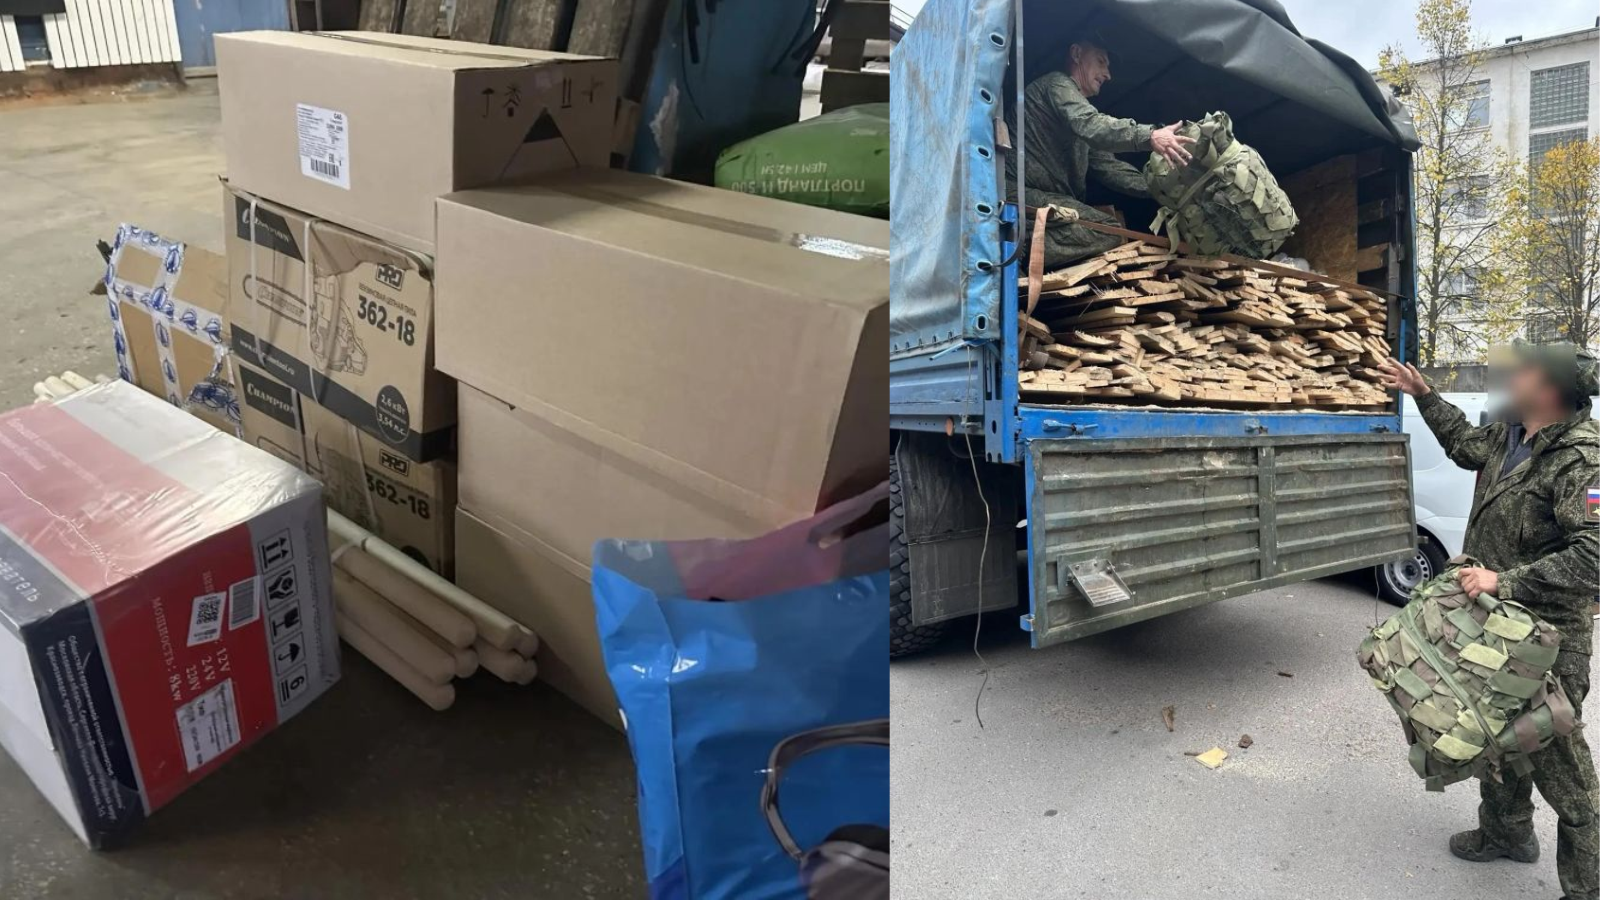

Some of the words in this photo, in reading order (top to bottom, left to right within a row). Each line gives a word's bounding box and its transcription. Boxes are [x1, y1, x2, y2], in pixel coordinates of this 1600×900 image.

[777, 178, 865, 193] ПОРТЛАНД
[357, 294, 416, 346] 362-18
[201, 655, 216, 681] 24V
[215, 647, 231, 672] 12V
[186, 665, 201, 691] 220V
